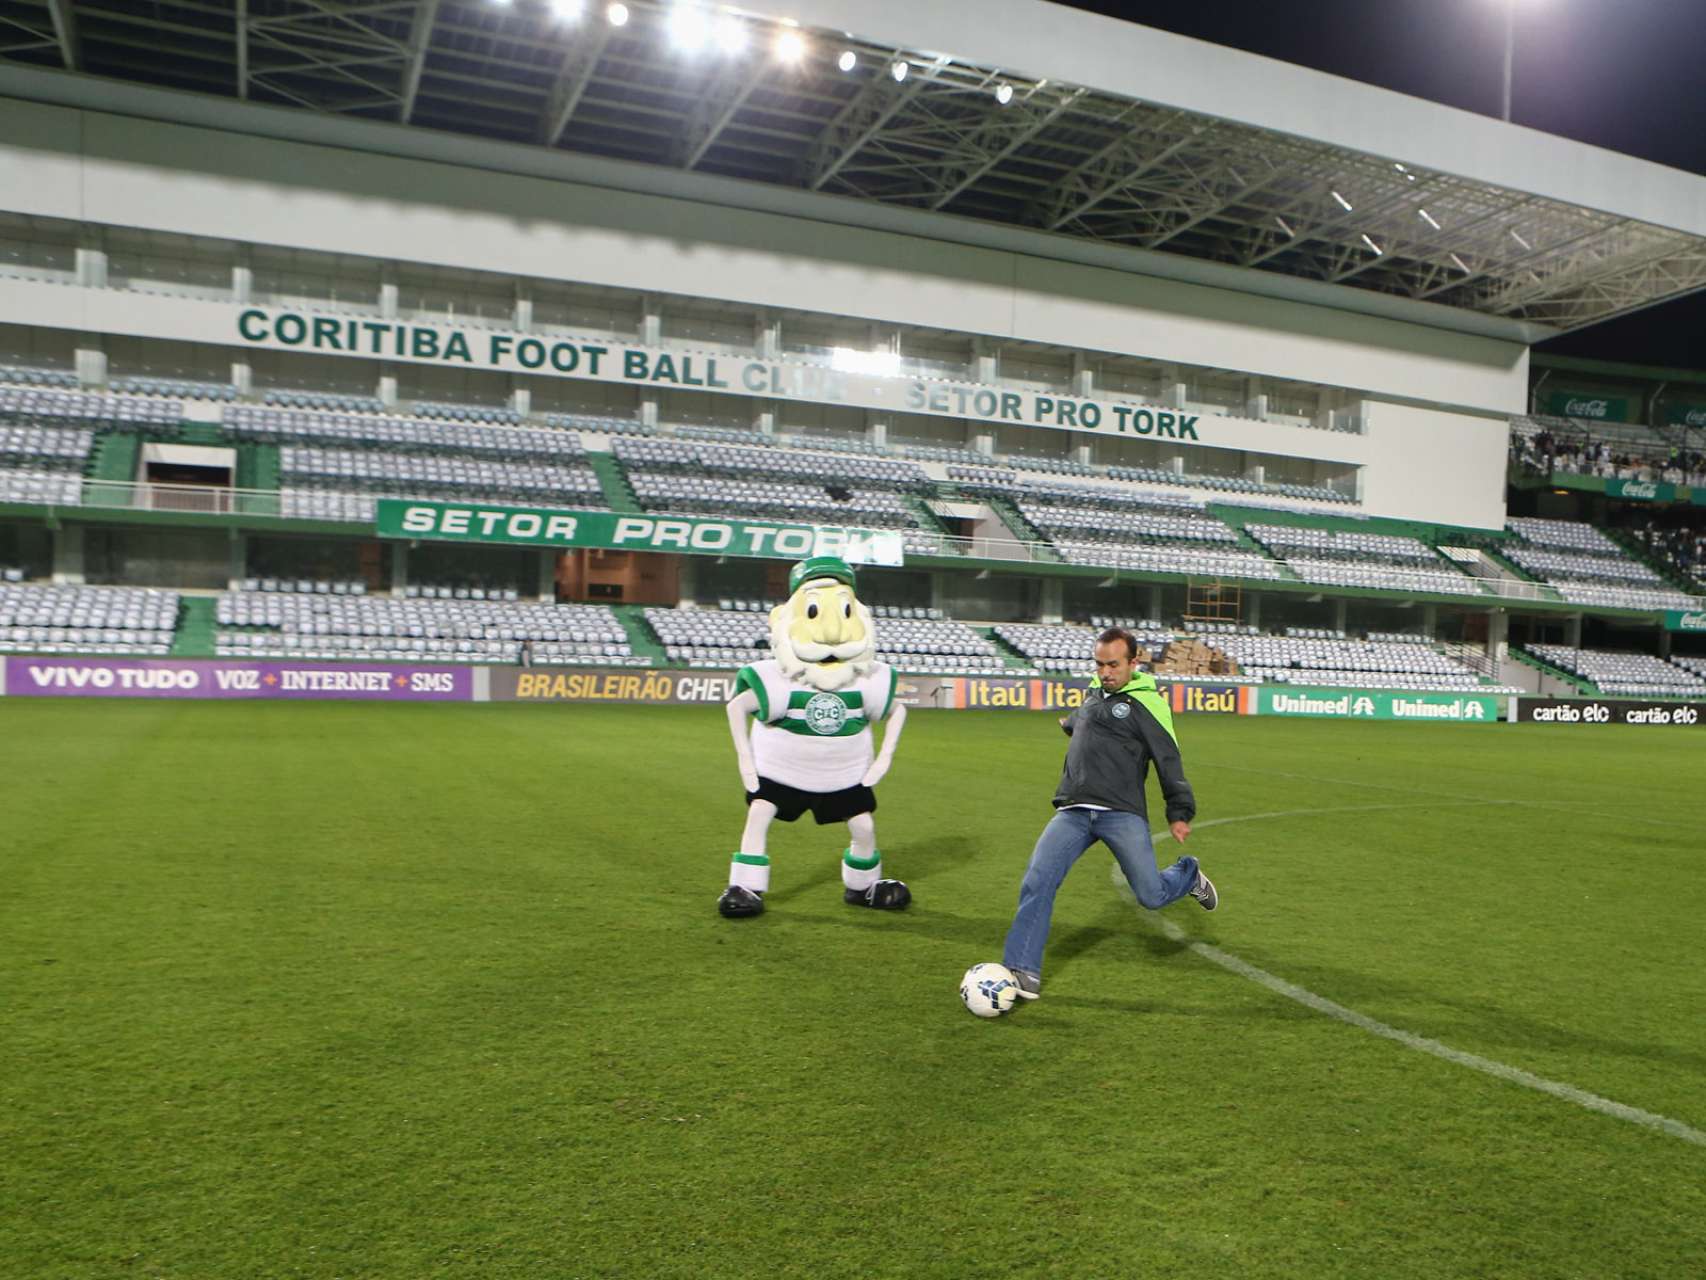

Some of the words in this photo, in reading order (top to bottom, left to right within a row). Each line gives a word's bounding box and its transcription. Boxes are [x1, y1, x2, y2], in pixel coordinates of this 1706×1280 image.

[238, 310, 472, 362] CORITIBA
[490, 335, 608, 376] FOOT
[624, 350, 728, 388] BALL
[740, 362, 842, 401] CL
[905, 382, 1023, 420] SETOR
[1034, 396, 1102, 428] PRO
[1112, 406, 1199, 441] TORK
[402, 507, 578, 540] SETOR
[613, 518, 734, 550] PRO
[29, 666, 115, 688] VIVO
[116, 668, 200, 689] TUDO
[214, 669, 261, 690] VOZ
[280, 670, 393, 691] INTERNET
[410, 672, 454, 692] SMS
[515, 670, 673, 701] BRASILEIRÃO
[676, 676, 736, 702] CHEV
[970, 680, 1026, 706] Itaú
[1046, 681, 1088, 708] Ita
[1187, 686, 1235, 712] Itaú
[1272, 693, 1349, 715] Unimed
[1392, 698, 1462, 718] Unimed
[1533, 704, 1580, 722] cartão
[1626, 707, 1671, 724] cartão
